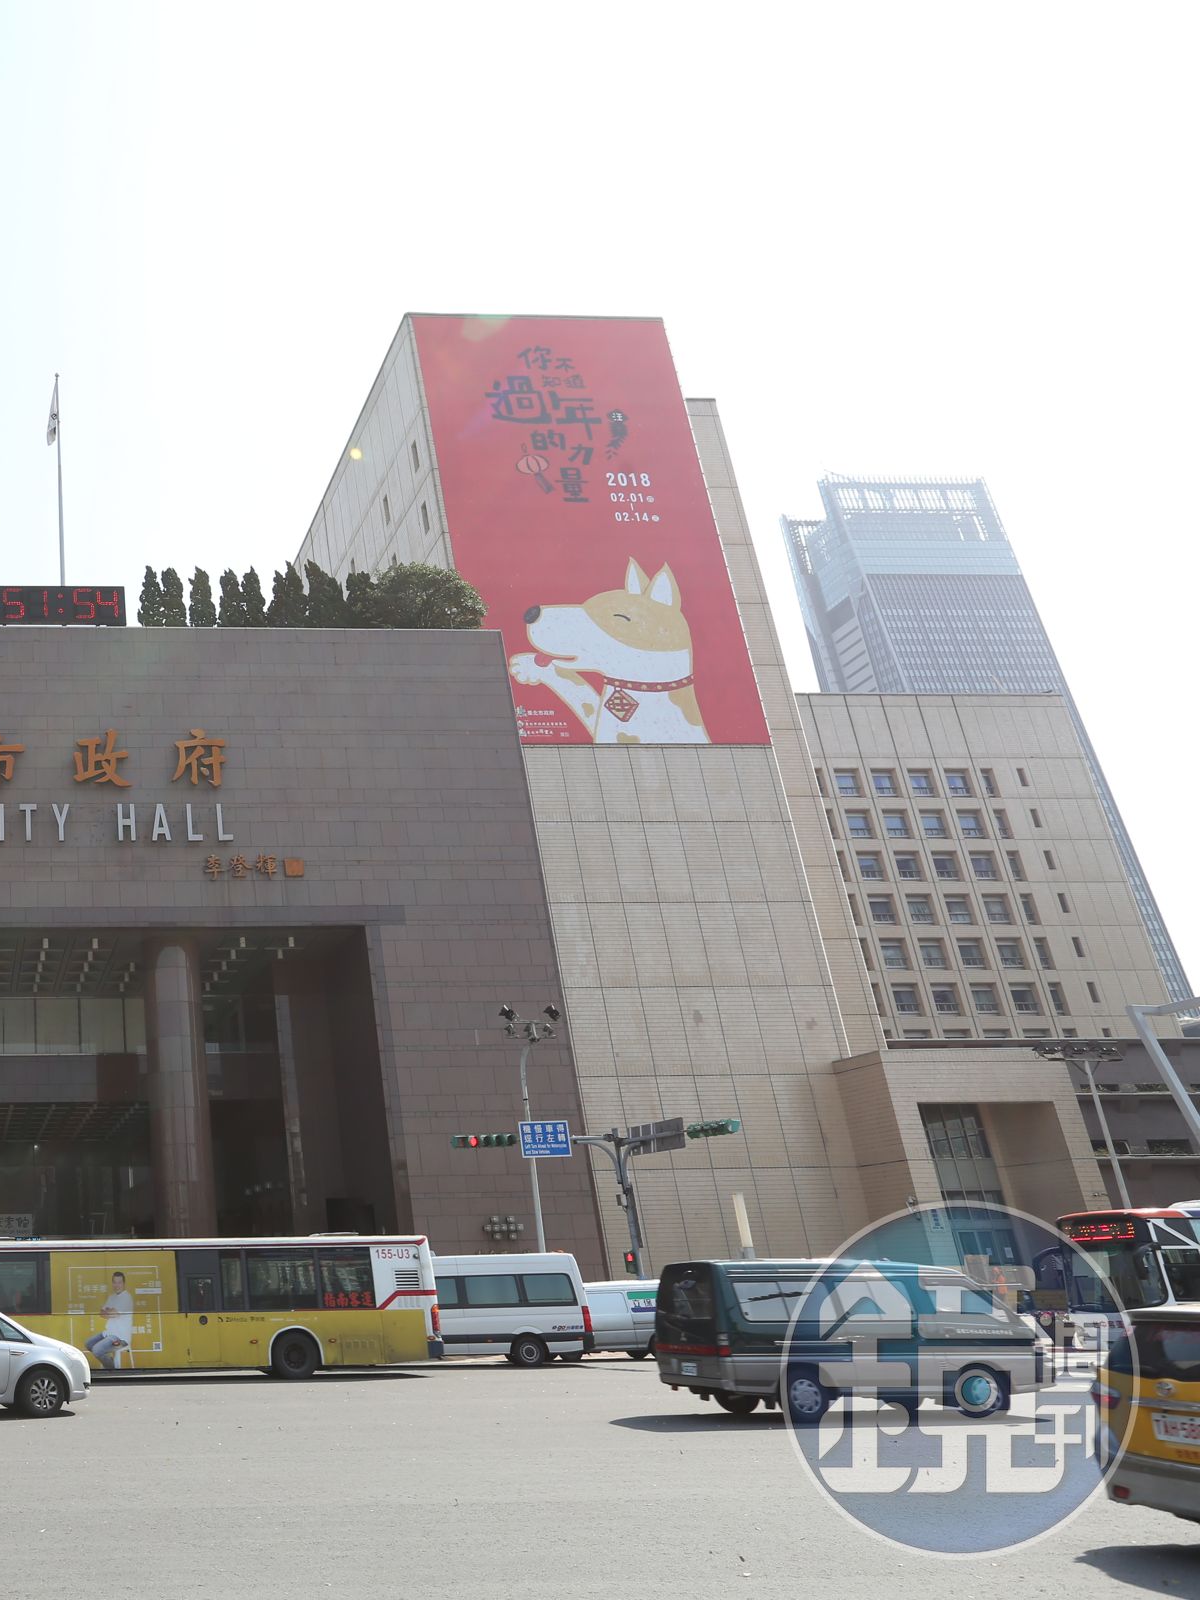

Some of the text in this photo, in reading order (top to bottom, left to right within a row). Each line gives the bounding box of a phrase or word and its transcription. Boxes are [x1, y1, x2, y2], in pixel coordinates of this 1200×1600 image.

[606, 472, 651, 487] 2018
[610, 492, 644, 503] 02.01
[615, 511, 650, 522] 02.14
[117, 803, 235, 842] HALL
[204, 854, 278, 880] 李登輝
[376, 1249, 410, 1259] 155-U3
